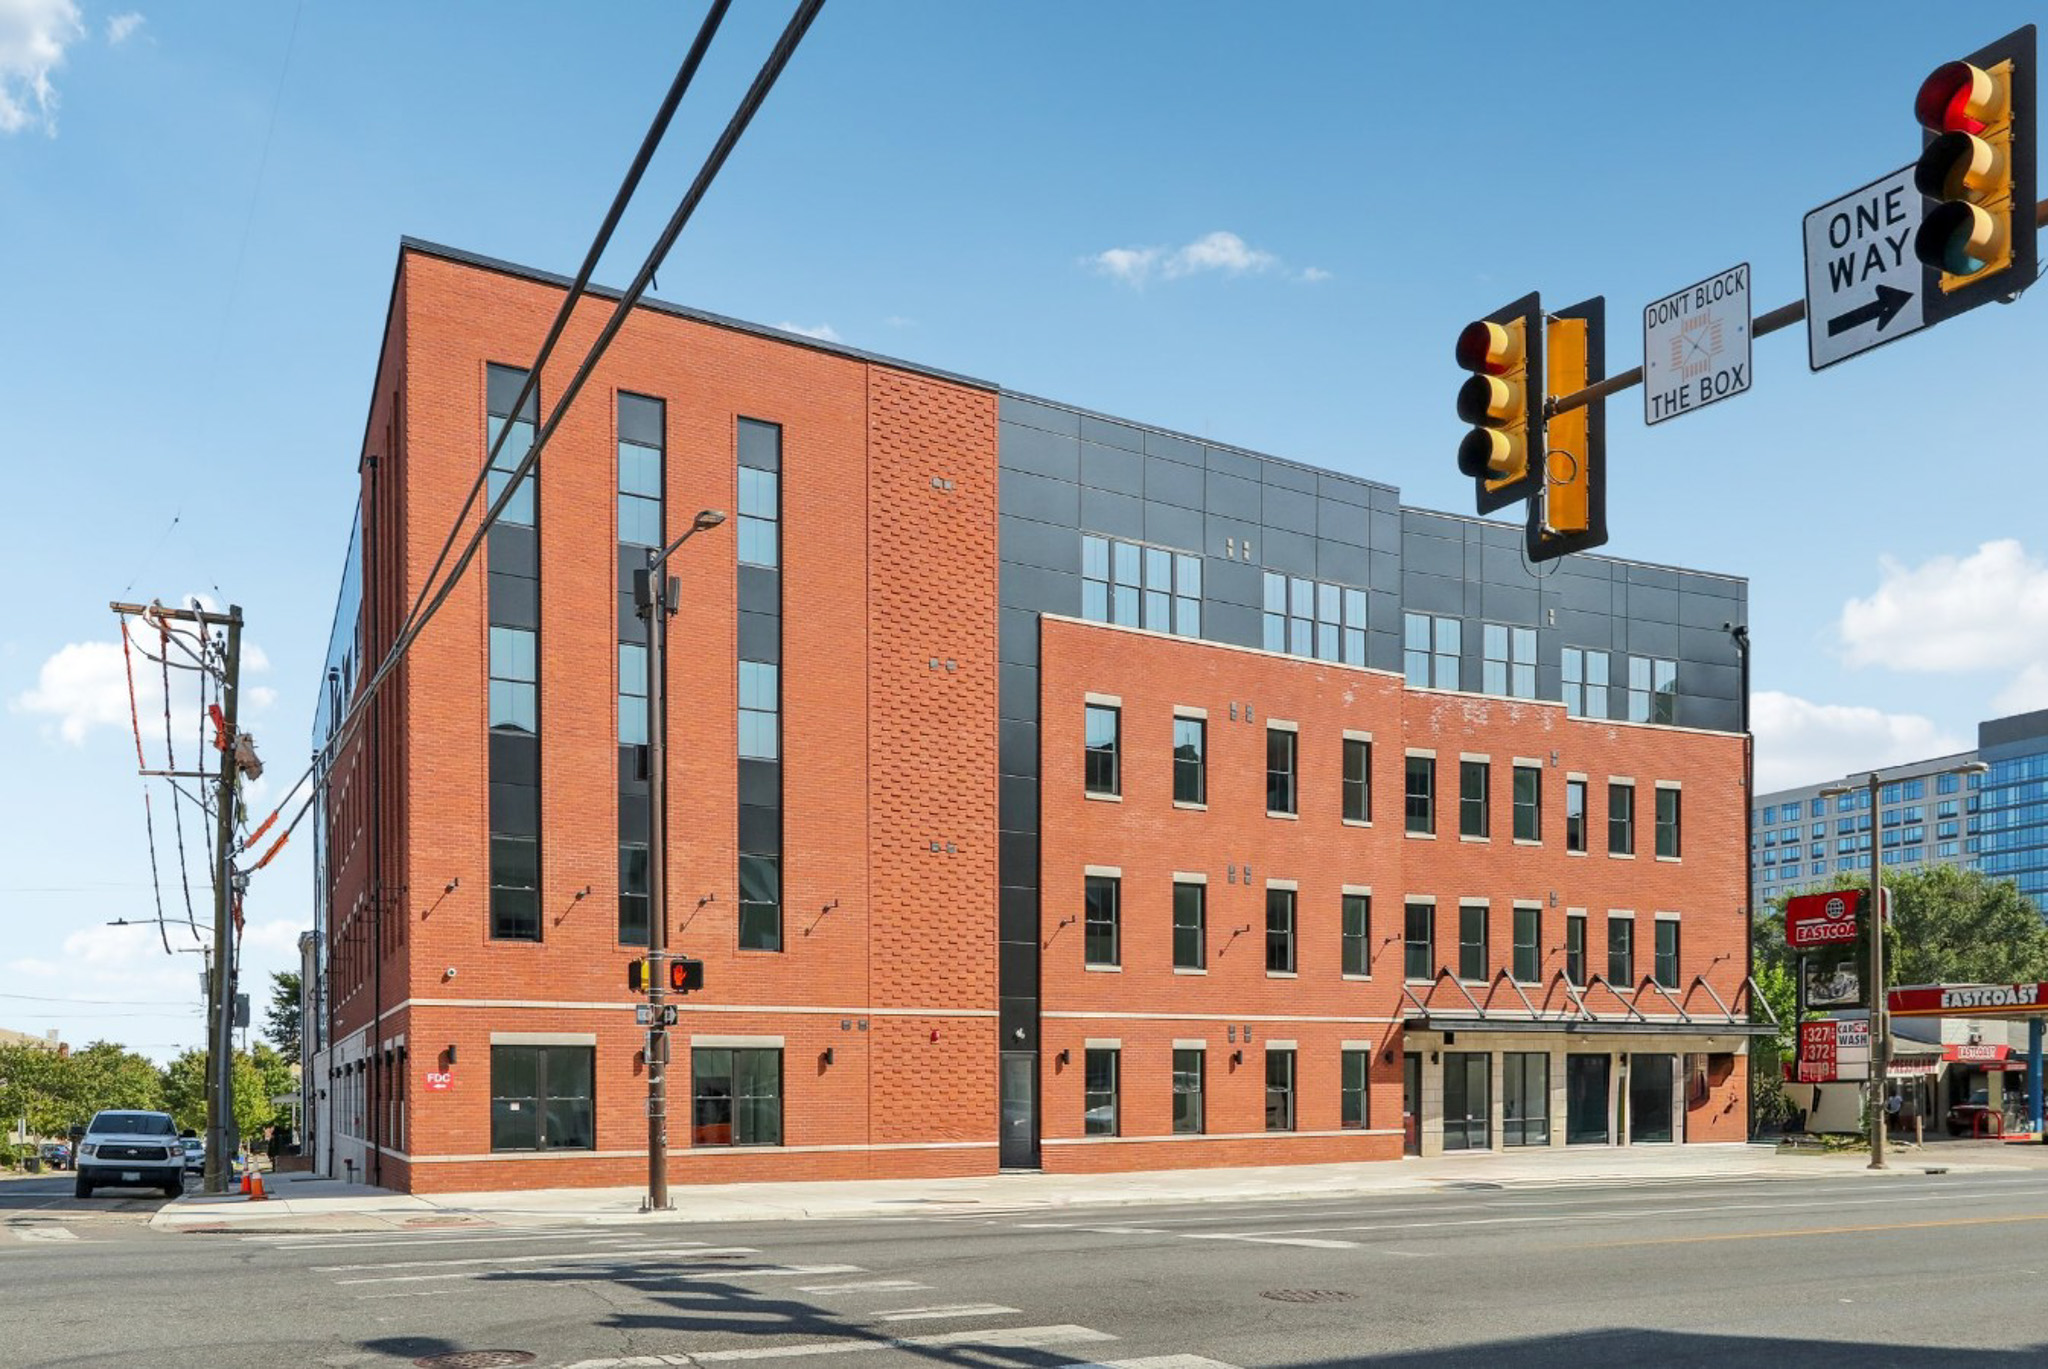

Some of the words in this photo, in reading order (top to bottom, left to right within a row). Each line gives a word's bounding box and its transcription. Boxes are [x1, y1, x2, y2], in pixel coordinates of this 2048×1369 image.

[1829, 186, 1907, 248] ONE
[1829, 228, 1910, 293] WAY
[1648, 293, 1689, 329] DON'T
[1696, 270, 1745, 308] BLOCK
[1652, 384, 1690, 418] THE
[1701, 363, 1745, 401] BOX
[1796, 921, 1857, 942] EASTCOA
[1941, 987, 2038, 1008] EASTCOAST
[1808, 1027, 1829, 1042] 327
[1838, 1024, 1855, 1034] CAR
[1839, 1035, 1867, 1045] WASH
[1808, 1044, 1829, 1060] 372
